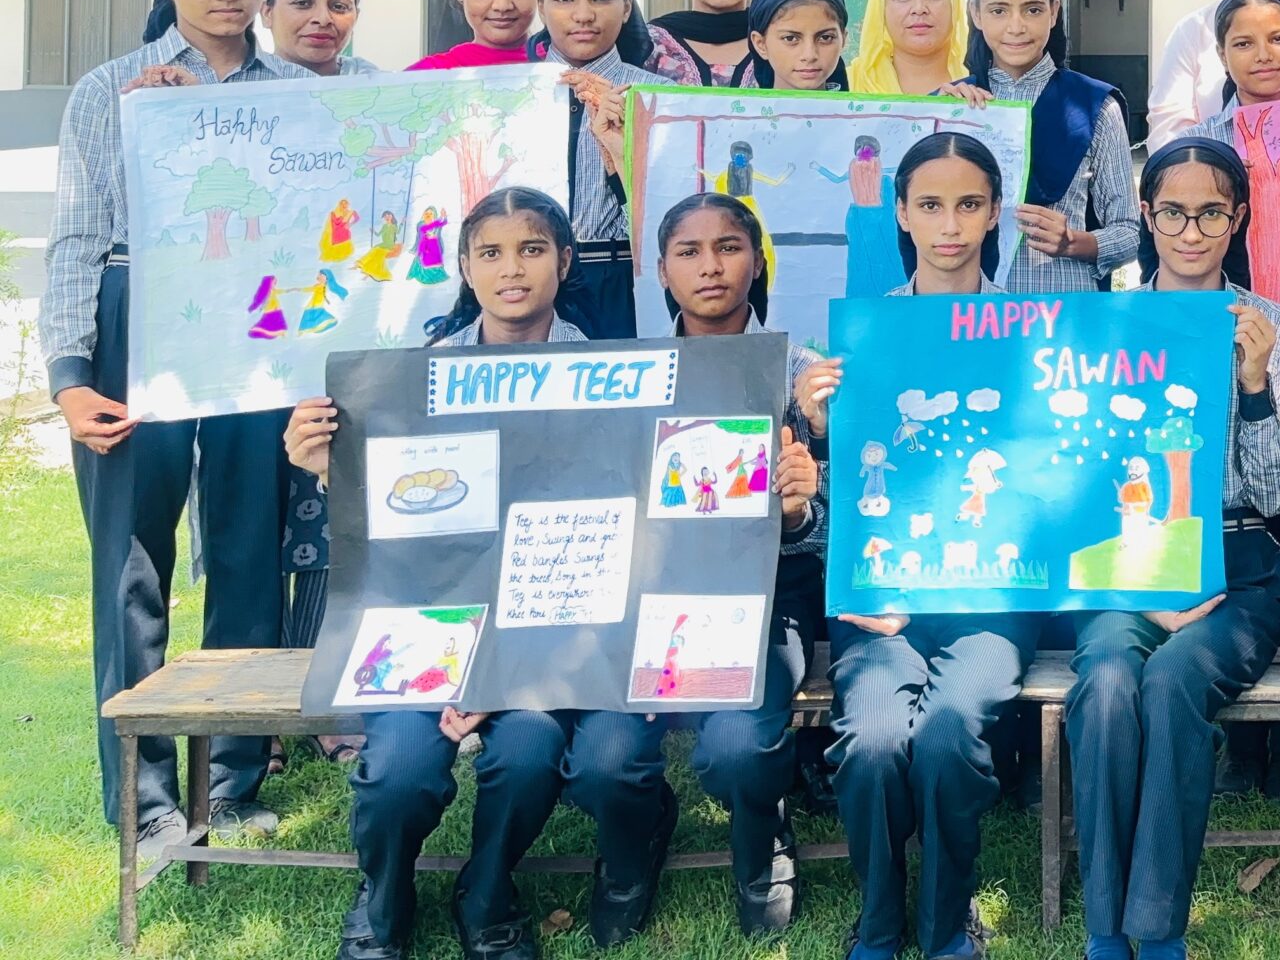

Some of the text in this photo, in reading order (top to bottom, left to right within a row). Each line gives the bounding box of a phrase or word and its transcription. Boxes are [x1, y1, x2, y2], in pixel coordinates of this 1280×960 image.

[193, 107, 280, 146] Happy
[268, 146, 346, 175] Sawan
[950, 300, 1063, 341] HAPPY
[1032, 346, 1168, 391] SAWAN
[446, 360, 656, 406] HAPPY TEEJ
[538, 515, 549, 526] is
[554, 513, 569, 525] the
[572, 510, 610, 531] festival
[578, 533, 597, 543] and
[511, 551, 527, 567] Red
[508, 573, 523, 583] the
[532, 590, 543, 599] is
